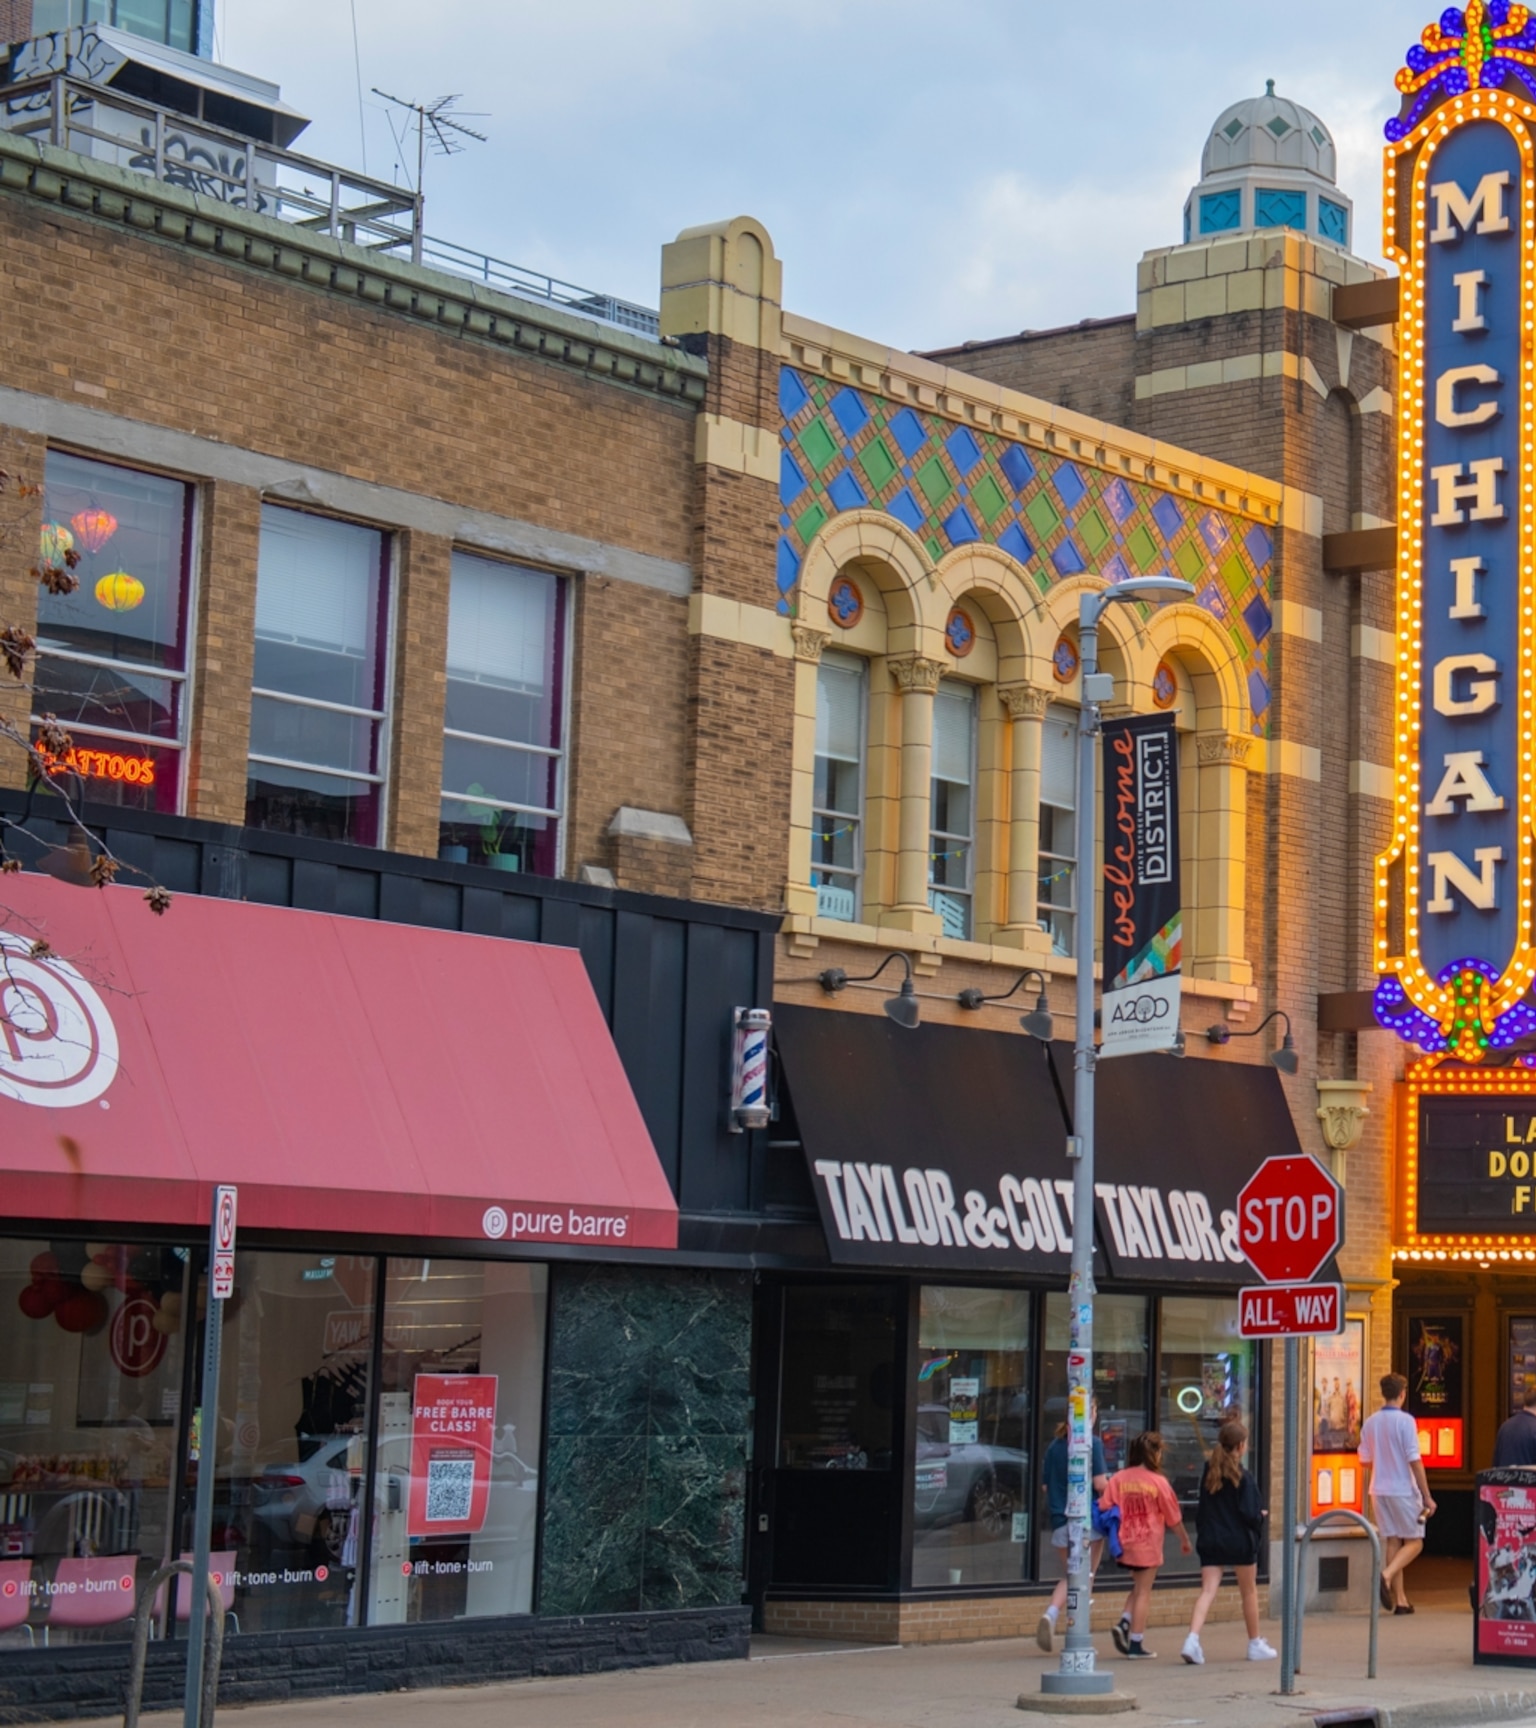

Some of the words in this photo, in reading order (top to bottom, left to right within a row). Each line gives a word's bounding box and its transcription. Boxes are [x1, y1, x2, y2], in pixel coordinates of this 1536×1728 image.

[1425, 170, 1510, 914] MICHIGAN
[1144, 742, 1166, 876] DISTRICT
[1104, 728, 1135, 947] welcome
[512, 1211, 563, 1238] pure
[568, 1209, 627, 1237] barre
[1244, 1194, 1333, 1244] STOP
[1244, 1298, 1280, 1328] ALL
[1294, 1294, 1334, 1324] WAY
[415, 1406, 447, 1419] FREE
[451, 1406, 493, 1419] BARRE
[430, 1421, 477, 1432] CLASS!
[225, 1570, 241, 1585] lift
[248, 1571, 276, 1585] tone
[284, 1569, 313, 1583] burn
[415, 1562, 430, 1575] lift
[435, 1561, 462, 1574] tone
[467, 1559, 493, 1572] burn
[20, 1580, 37, 1595] lift
[46, 1581, 77, 1594] tone
[85, 1578, 117, 1593] burn
